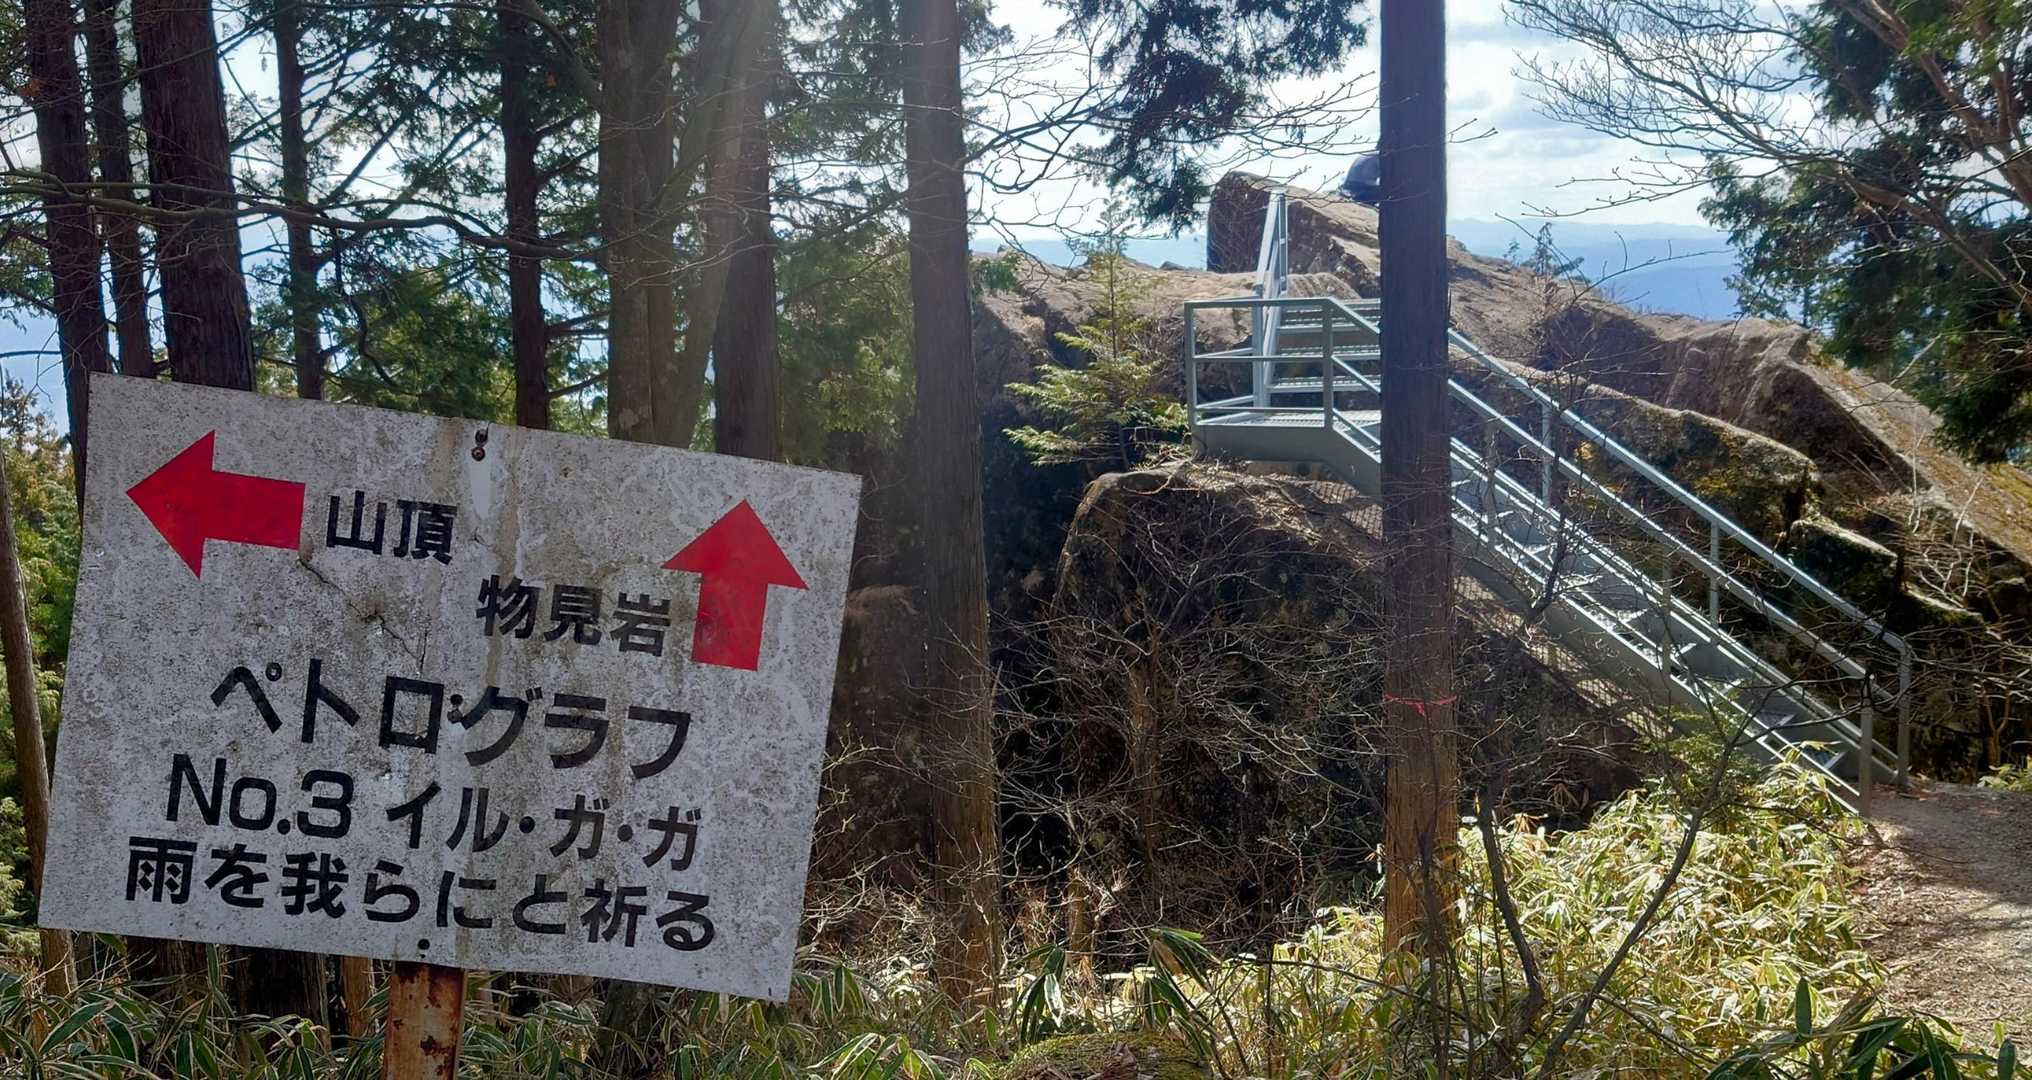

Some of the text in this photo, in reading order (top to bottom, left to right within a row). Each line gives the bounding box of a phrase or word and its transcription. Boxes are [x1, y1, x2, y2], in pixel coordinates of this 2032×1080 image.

[326, 490, 459, 565] 山頂
[475, 576, 672, 657] 物見岩
[211, 657, 692, 779] ペトログラフ
[166, 754, 353, 839] No.3
[125, 836, 716, 951] 雨を我らにと祈る
